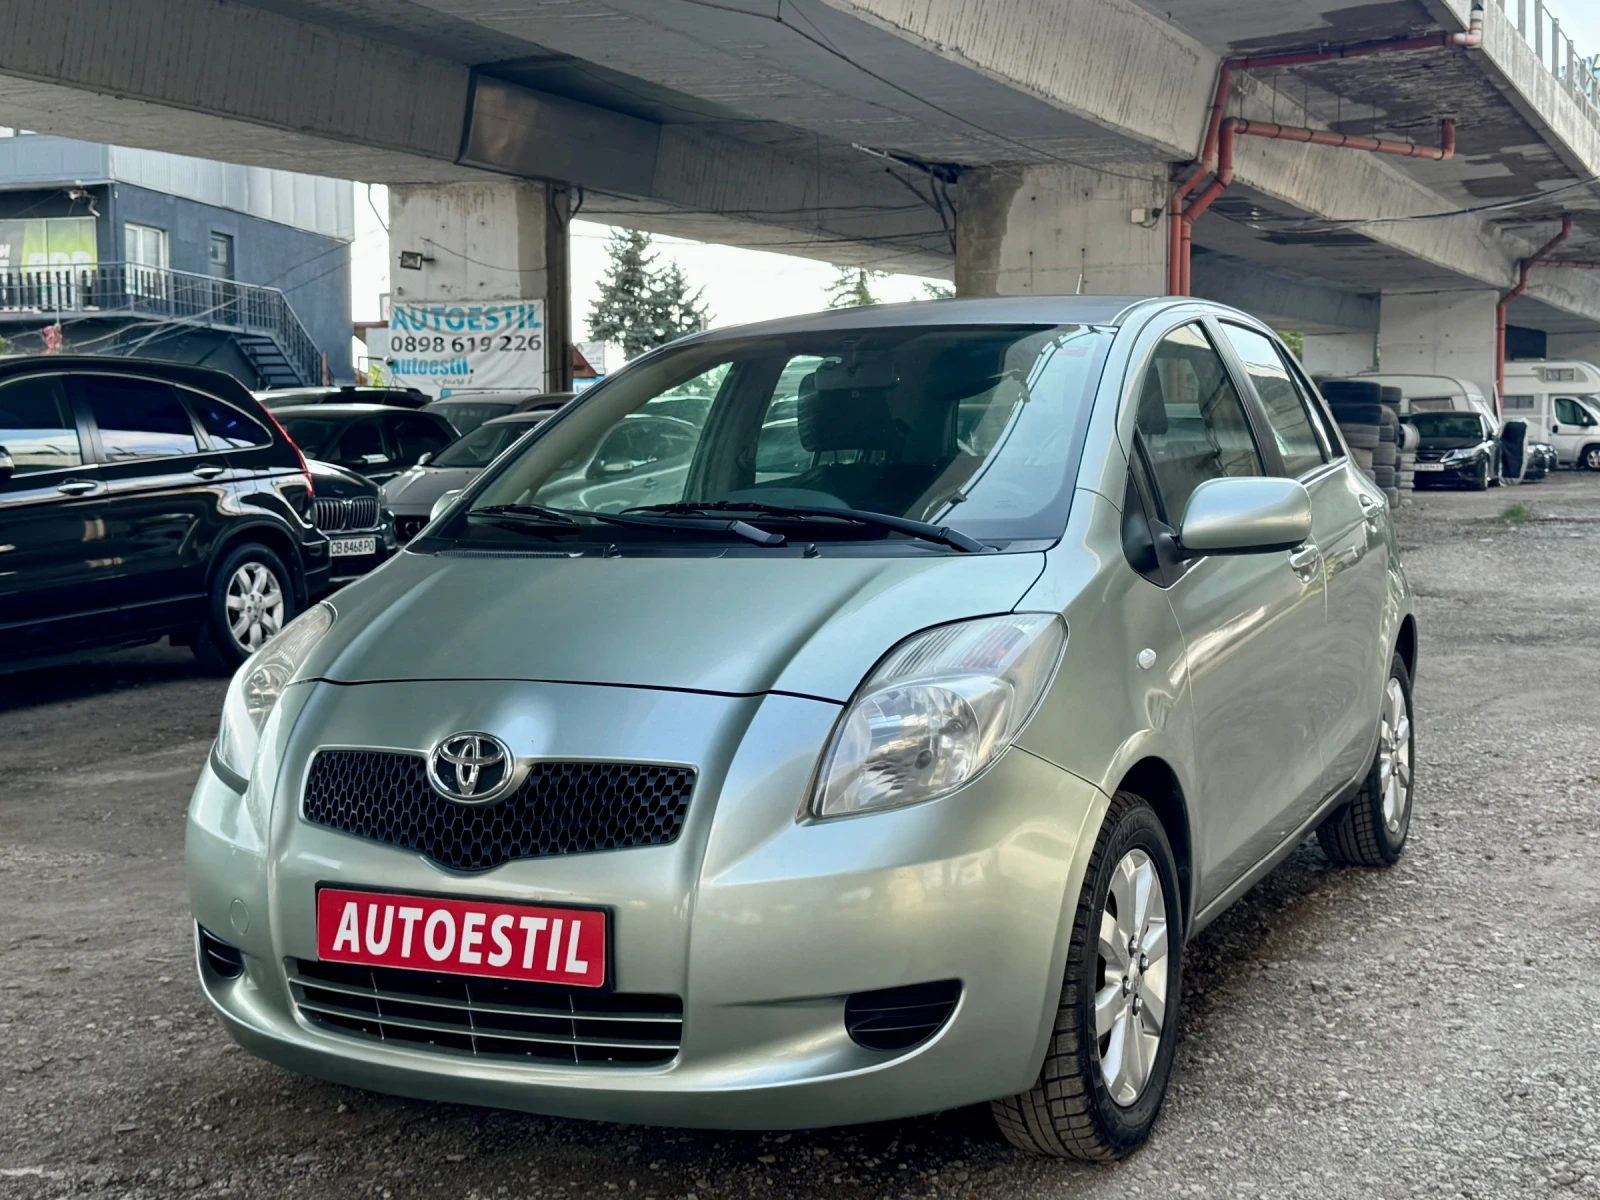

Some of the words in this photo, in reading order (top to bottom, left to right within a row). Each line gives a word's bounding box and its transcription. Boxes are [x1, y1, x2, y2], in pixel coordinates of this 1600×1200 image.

[391, 304, 542, 331] AUTOESTIL
[391, 336, 445, 353] 0898
[451, 336, 492, 352] 619
[499, 335, 542, 351] 226
[332, 901, 588, 974] AUTOESTIL
